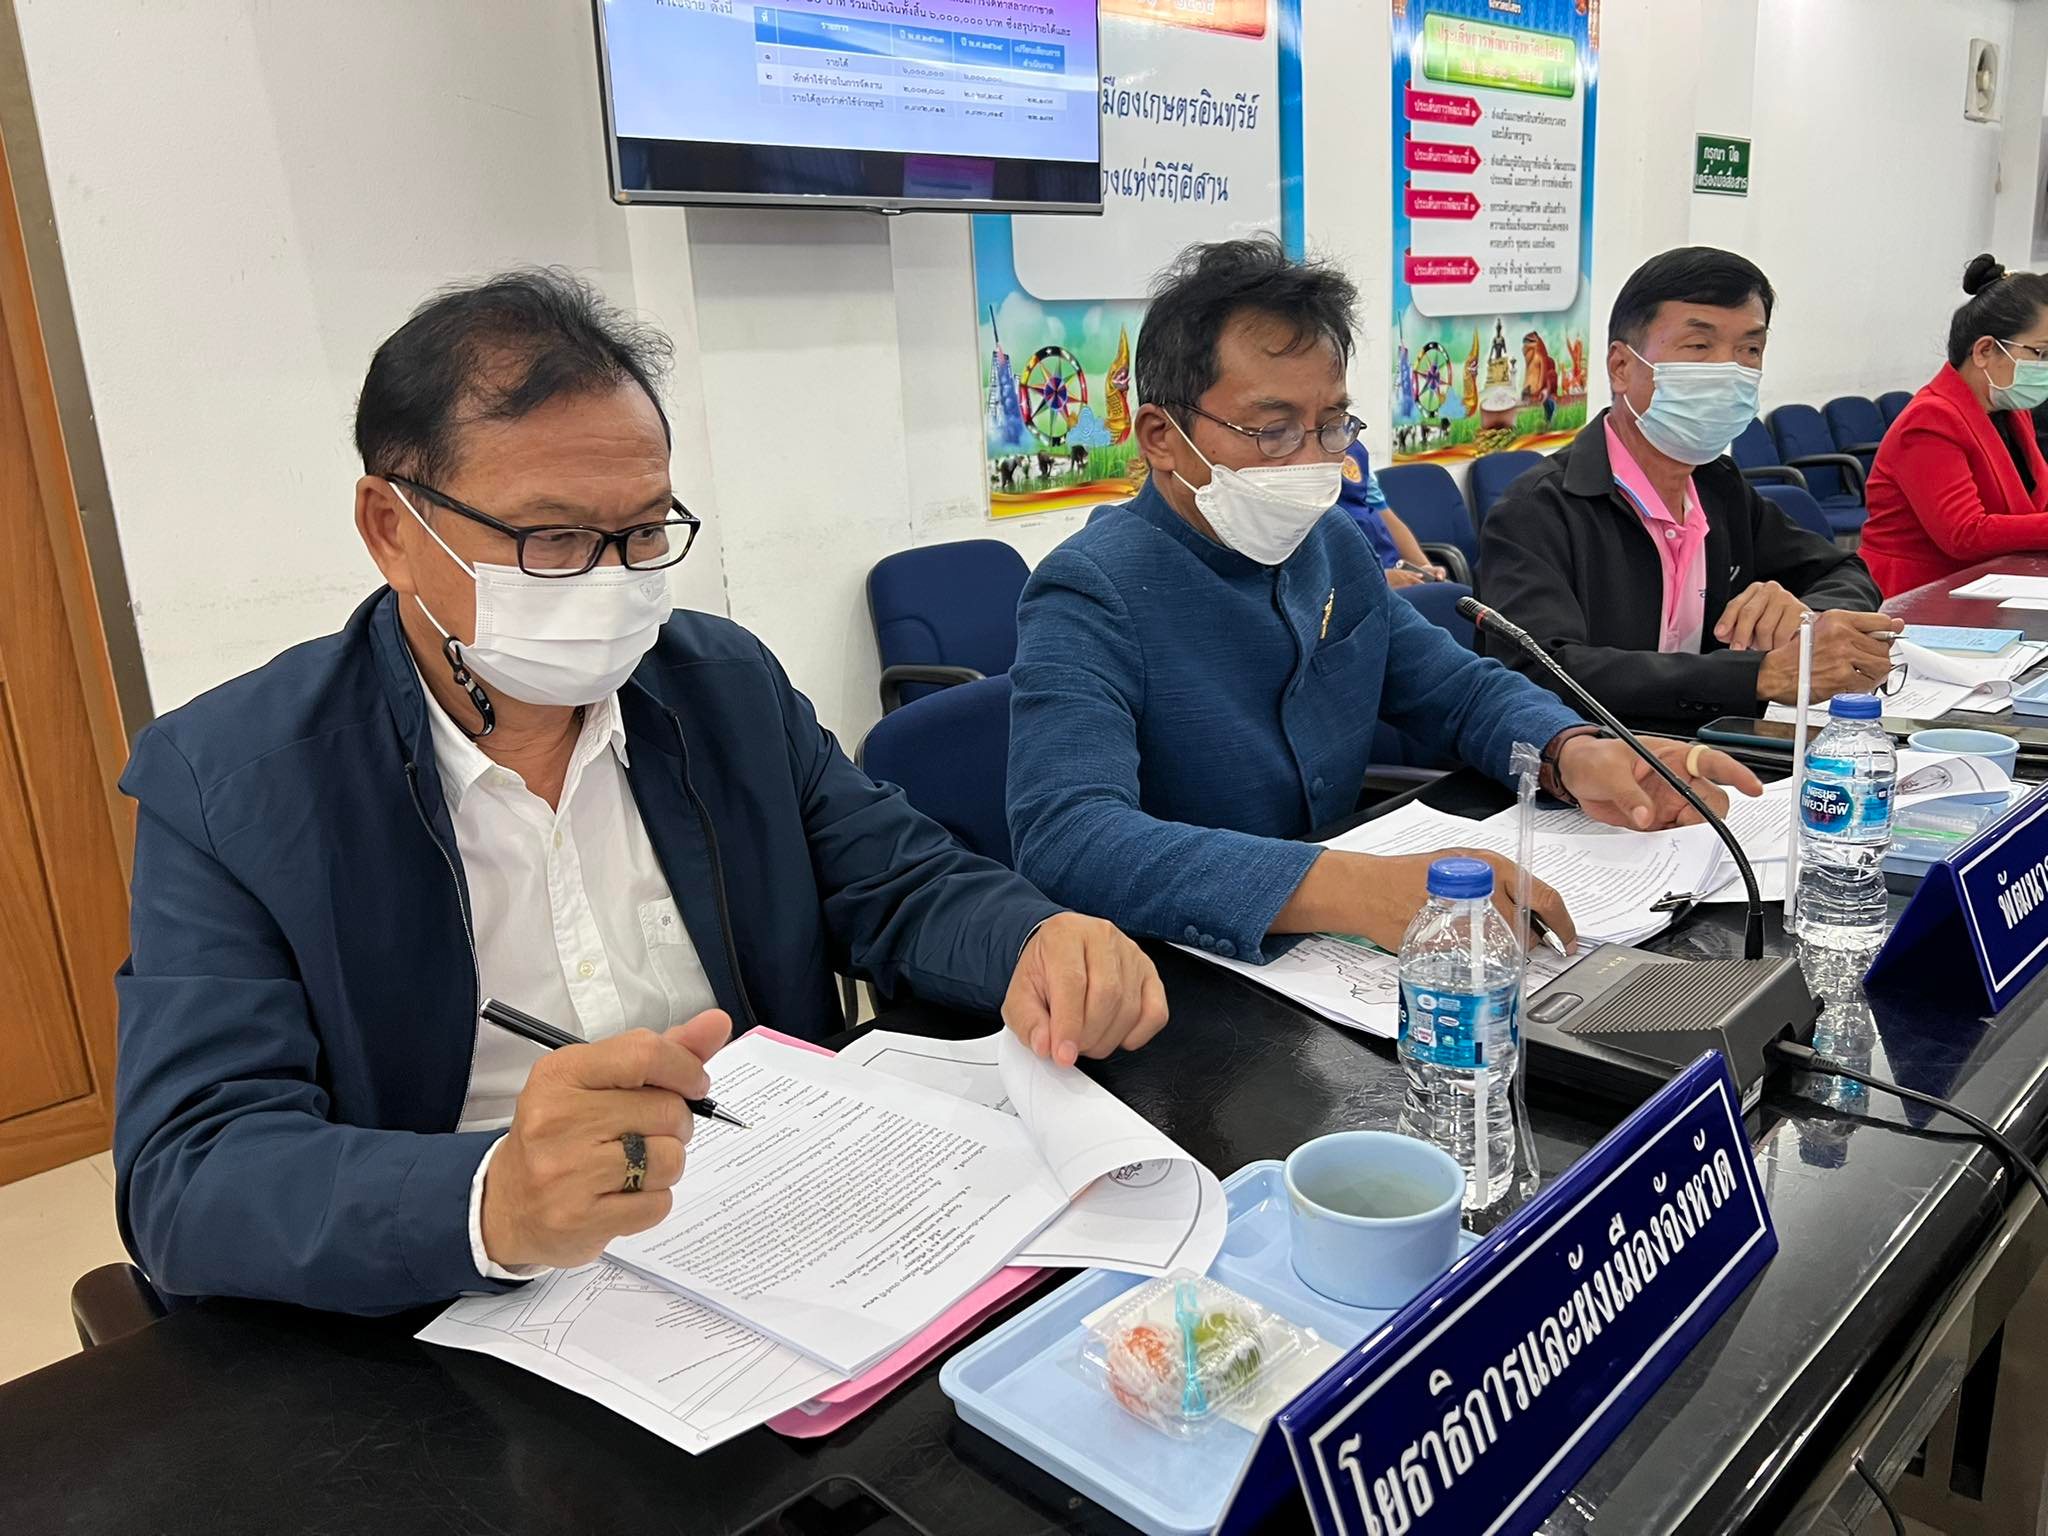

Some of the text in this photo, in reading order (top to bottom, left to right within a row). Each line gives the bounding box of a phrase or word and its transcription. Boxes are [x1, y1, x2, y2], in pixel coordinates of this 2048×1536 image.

[985, 17, 1003, 28] บาท
[1102, 75, 1261, 132] มืองเกษตรอินทรีย์
[1703, 144, 1740, 165] กรุณา ปิด
[1695, 164, 1748, 189] เครื่องมือสื่อสาร
[1997, 854, 2048, 930] พัฒนา
[1338, 1129, 1738, 1536] โยธาธิการและผังเมืองจังหวัด
